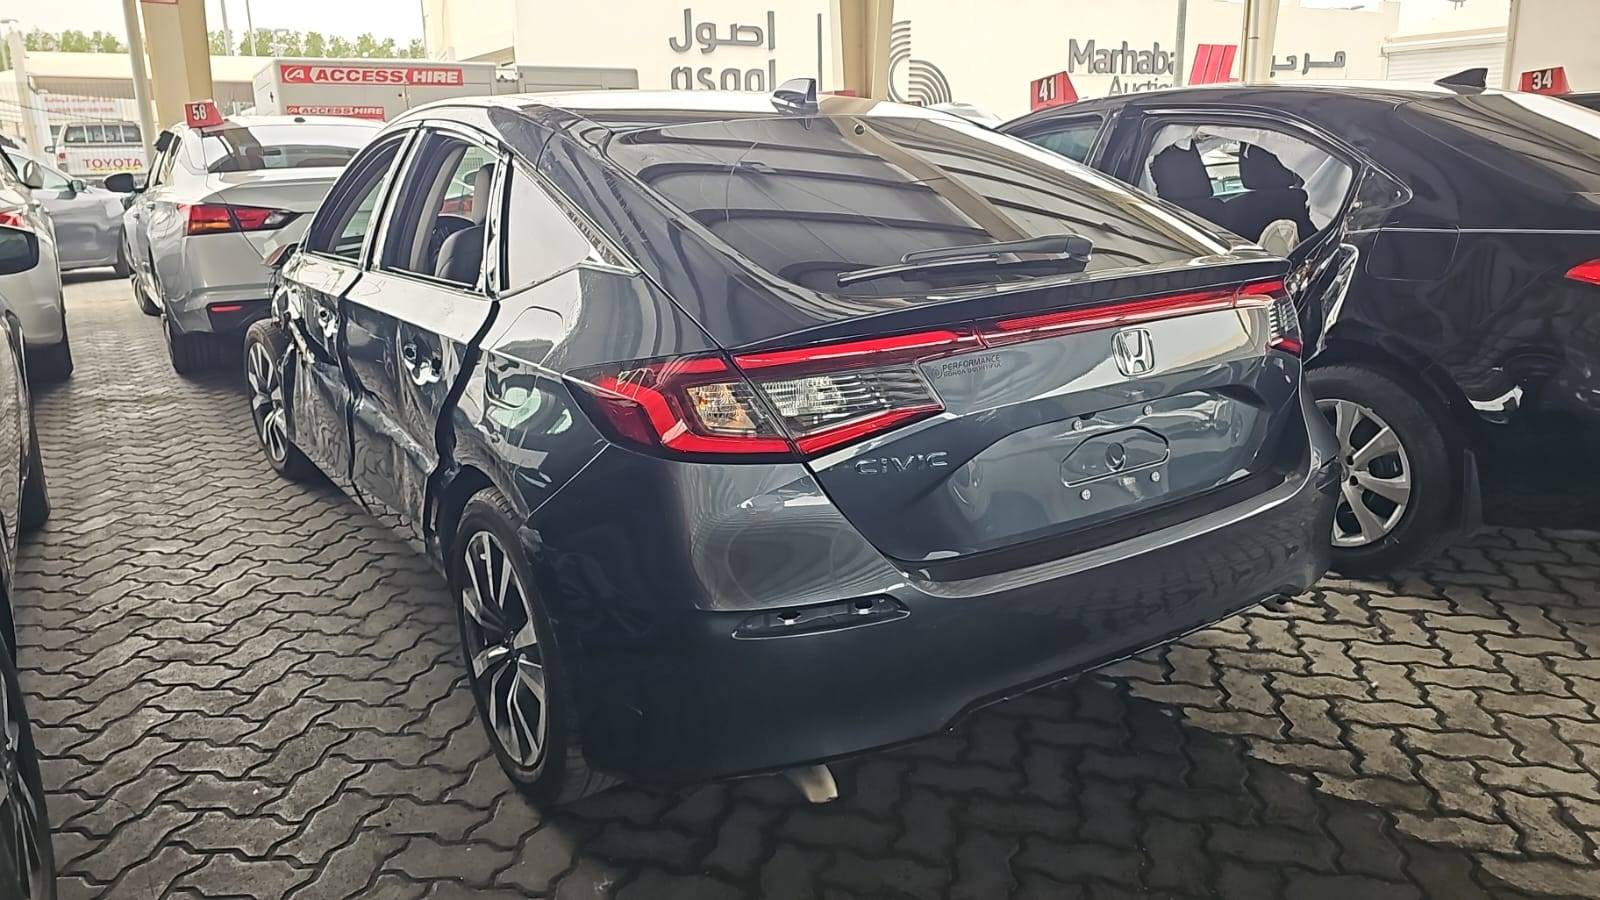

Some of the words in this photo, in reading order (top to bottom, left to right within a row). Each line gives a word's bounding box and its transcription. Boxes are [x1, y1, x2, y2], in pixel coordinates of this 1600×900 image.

[669, 8, 776, 54] اصول
[1269, 51, 1346, 78] مرحب
[314, 69, 404, 83] ACCESS
[413, 70, 459, 84] HIRE
[1532, 69, 1552, 90] 34
[1039, 76, 1055, 102] 41
[191, 103, 207, 121] 58
[301, 106, 352, 115] ACCESS
[354, 106, 383, 115] HIRE
[82, 158, 143, 168] TOYOTA
[942, 354, 1001, 372] PERFORMANCE
[854, 451, 948, 475] CIVIC
